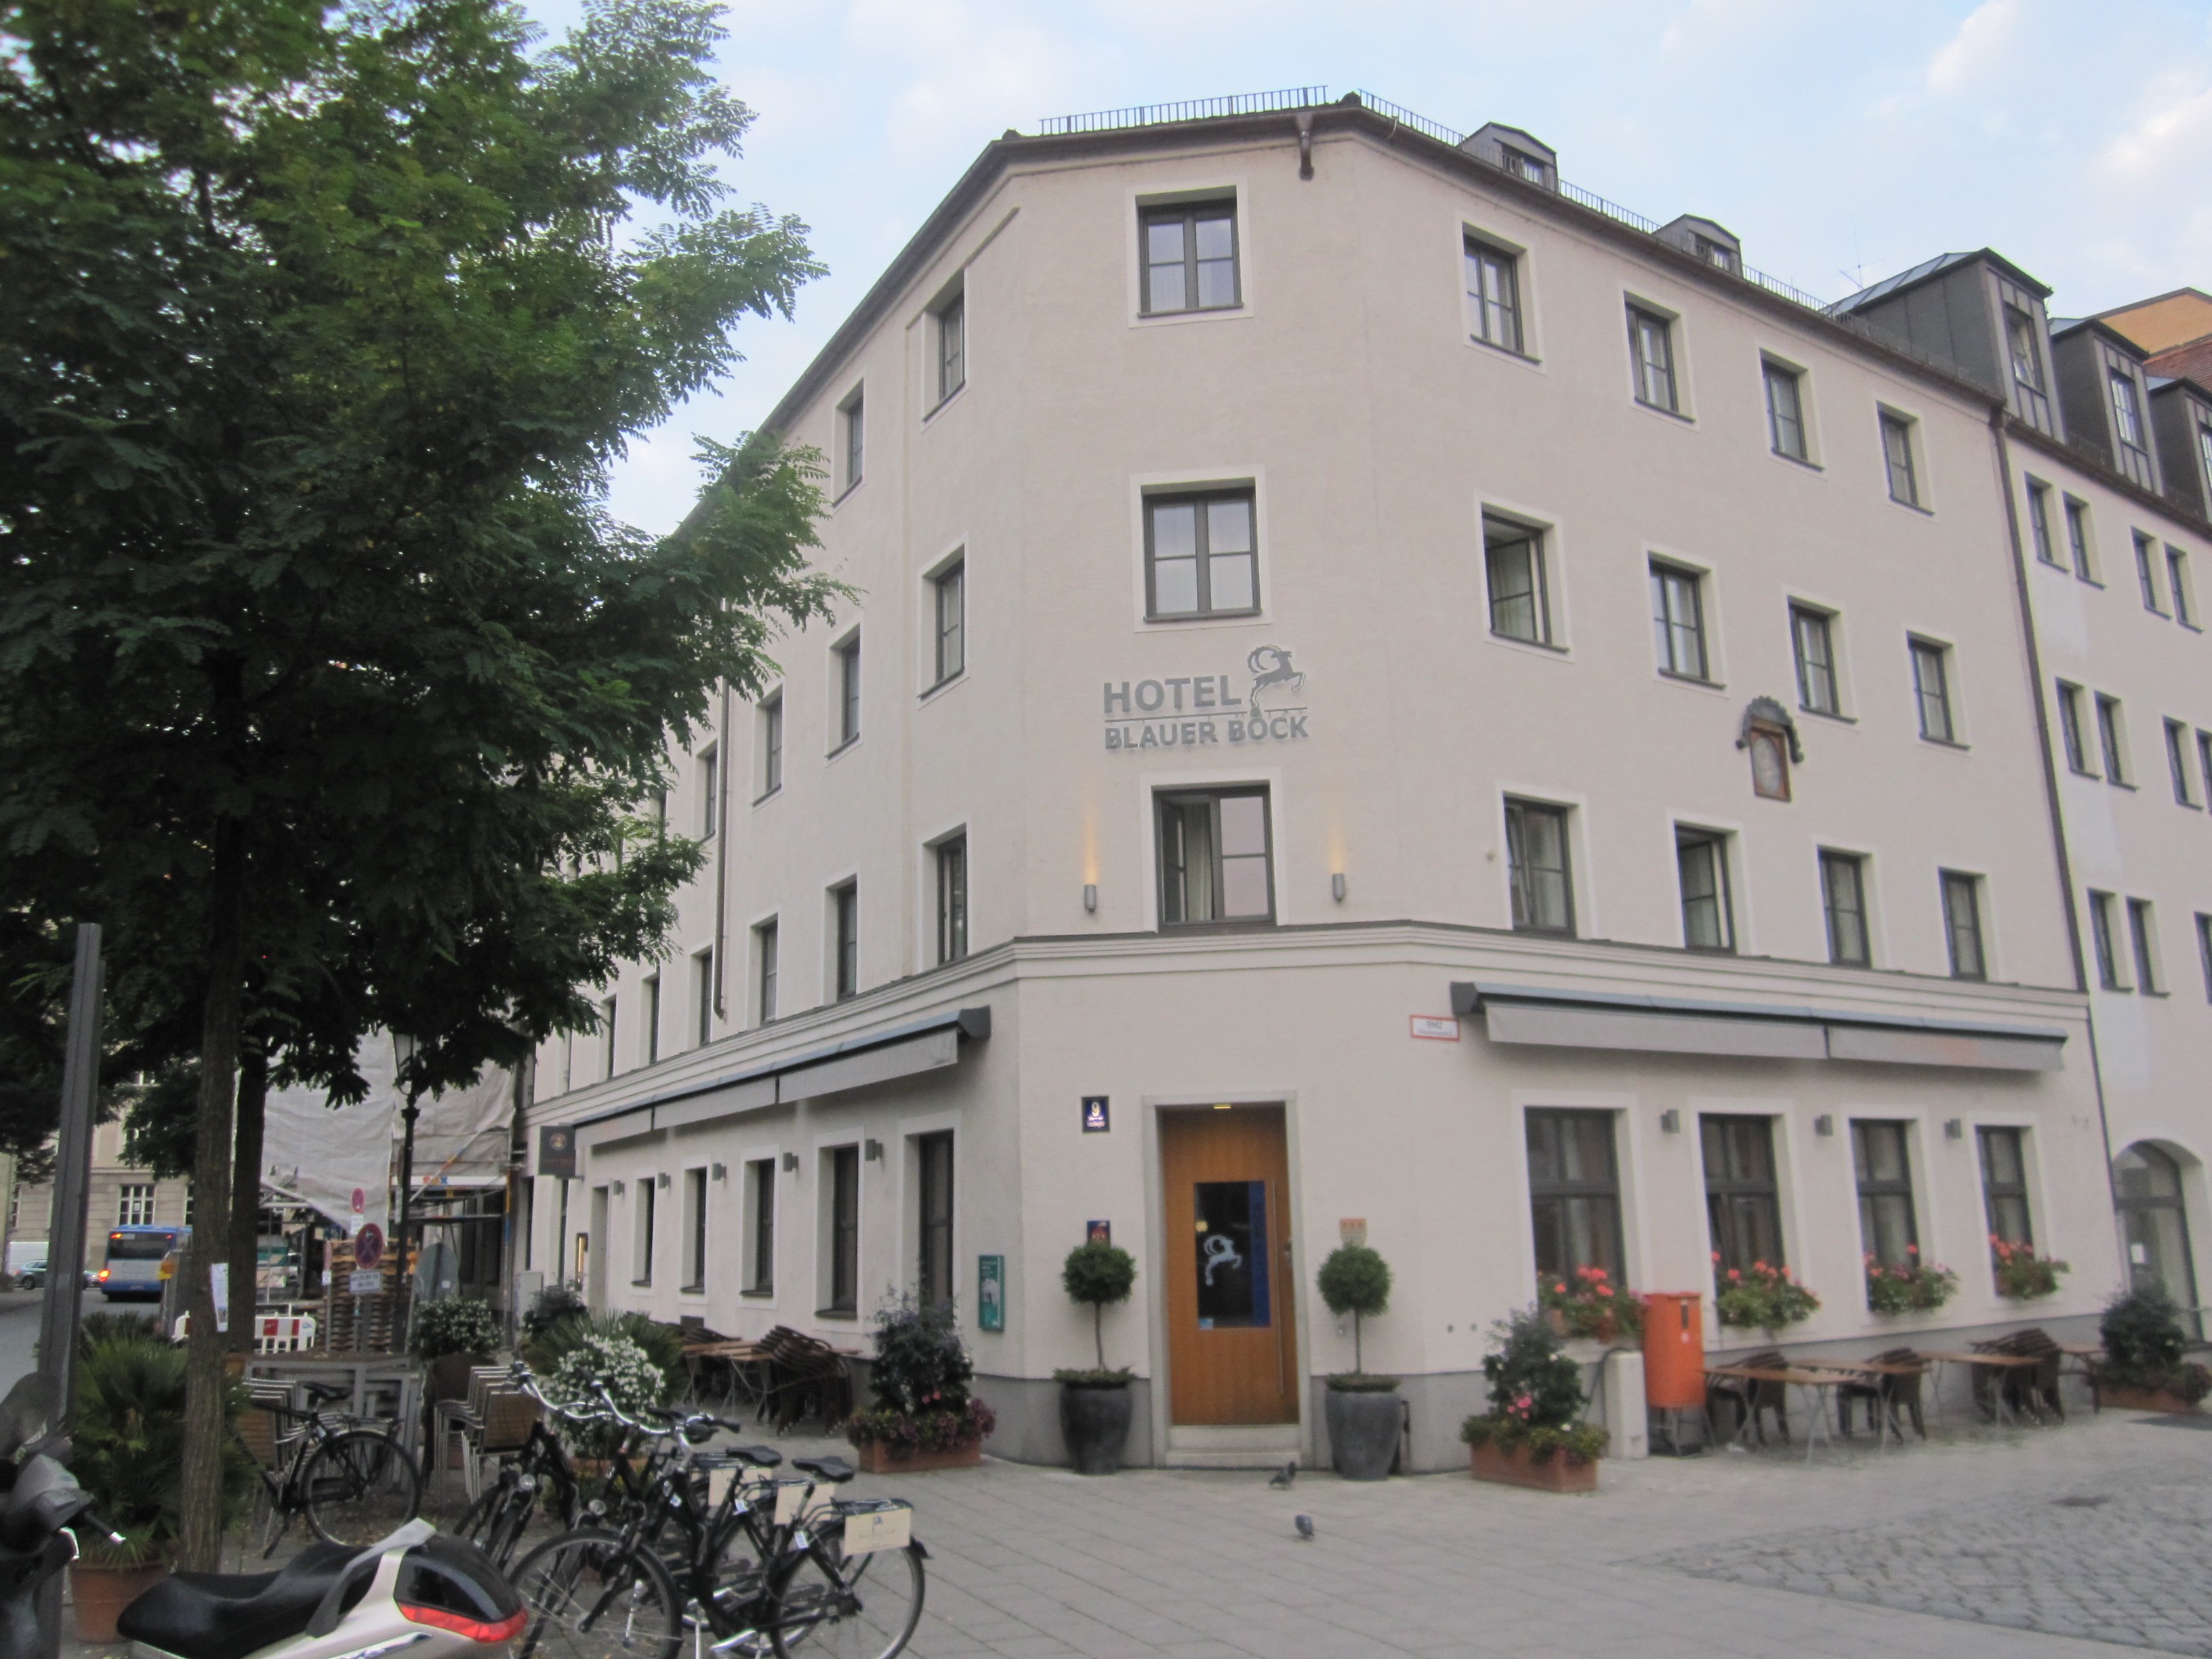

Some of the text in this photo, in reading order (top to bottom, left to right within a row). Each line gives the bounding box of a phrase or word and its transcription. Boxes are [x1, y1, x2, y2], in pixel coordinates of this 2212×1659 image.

[1103, 675, 1242, 713] HOTEL
[1105, 716, 1309, 749] BLAUER BOCK
